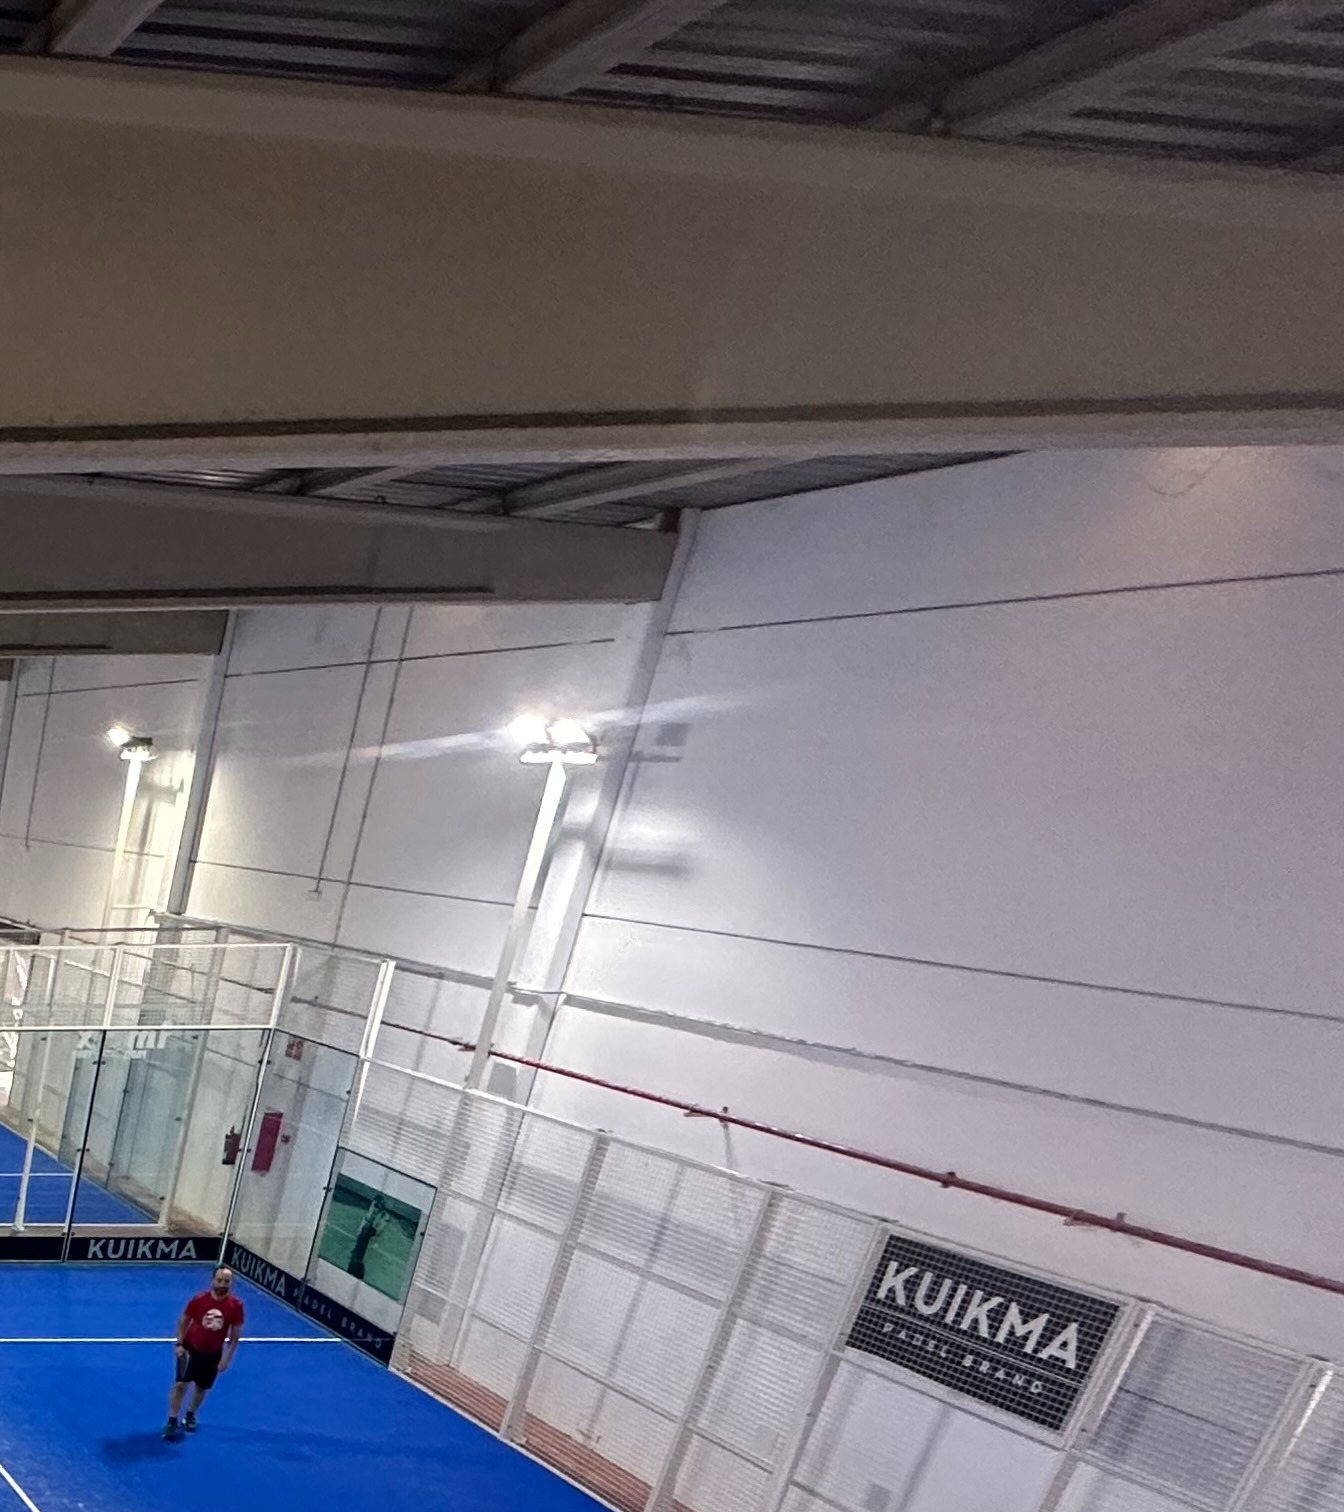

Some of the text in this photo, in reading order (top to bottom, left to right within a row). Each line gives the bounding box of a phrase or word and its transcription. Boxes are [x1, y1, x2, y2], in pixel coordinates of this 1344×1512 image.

[87, 1239, 197, 1259] KUIKMA
[231, 1246, 286, 1297] KUIKMA
[875, 1260, 1080, 1370] KUIKMA
[882, 1322, 1044, 1394] PADEL BRAND
